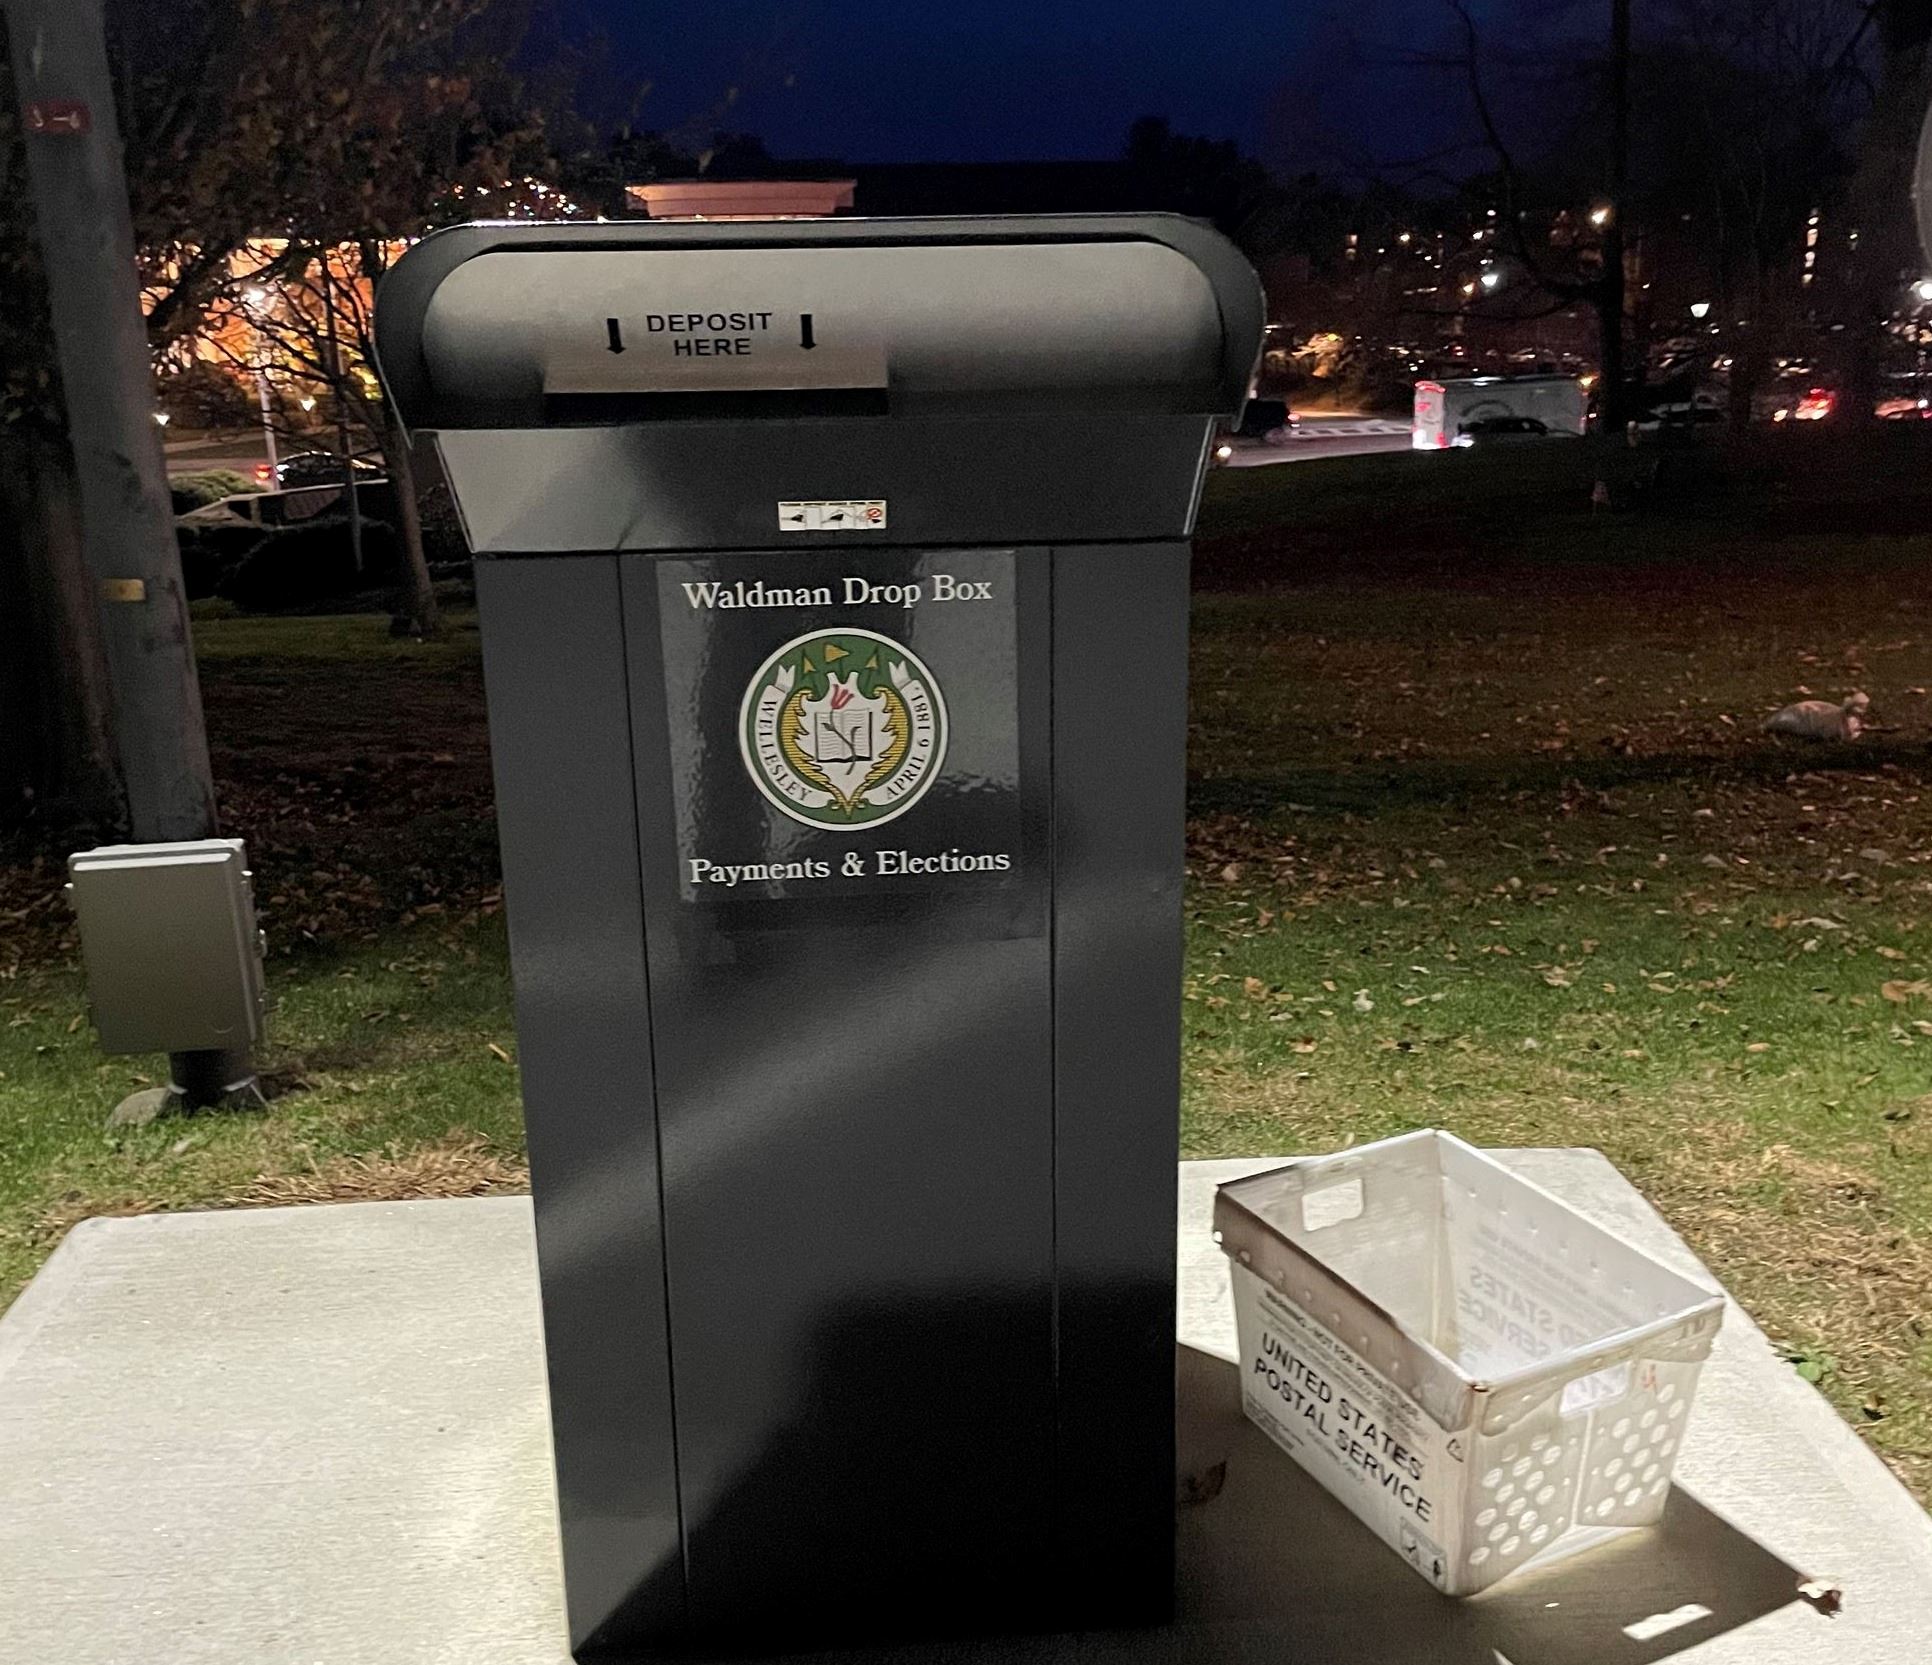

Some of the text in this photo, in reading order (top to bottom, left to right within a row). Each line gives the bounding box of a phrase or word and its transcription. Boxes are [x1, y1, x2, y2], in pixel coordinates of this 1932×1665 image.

[646, 312, 773, 333] DEPOSIT
[674, 338, 752, 357] HERE
[682, 574, 993, 609] Waldman Drop Box
[759, 700, 813, 801] WELLESLEY
[886, 755, 926, 801] APRIL
[918, 738, 930, 748] 6
[689, 848, 1011, 887] Payments & Elections
[1262, 1331, 1333, 1405] UNITED
[1337, 1397, 1426, 1482] STATES
[1254, 1357, 1329, 1436] POSTAL
[1337, 1428, 1433, 1523] SERVICE
